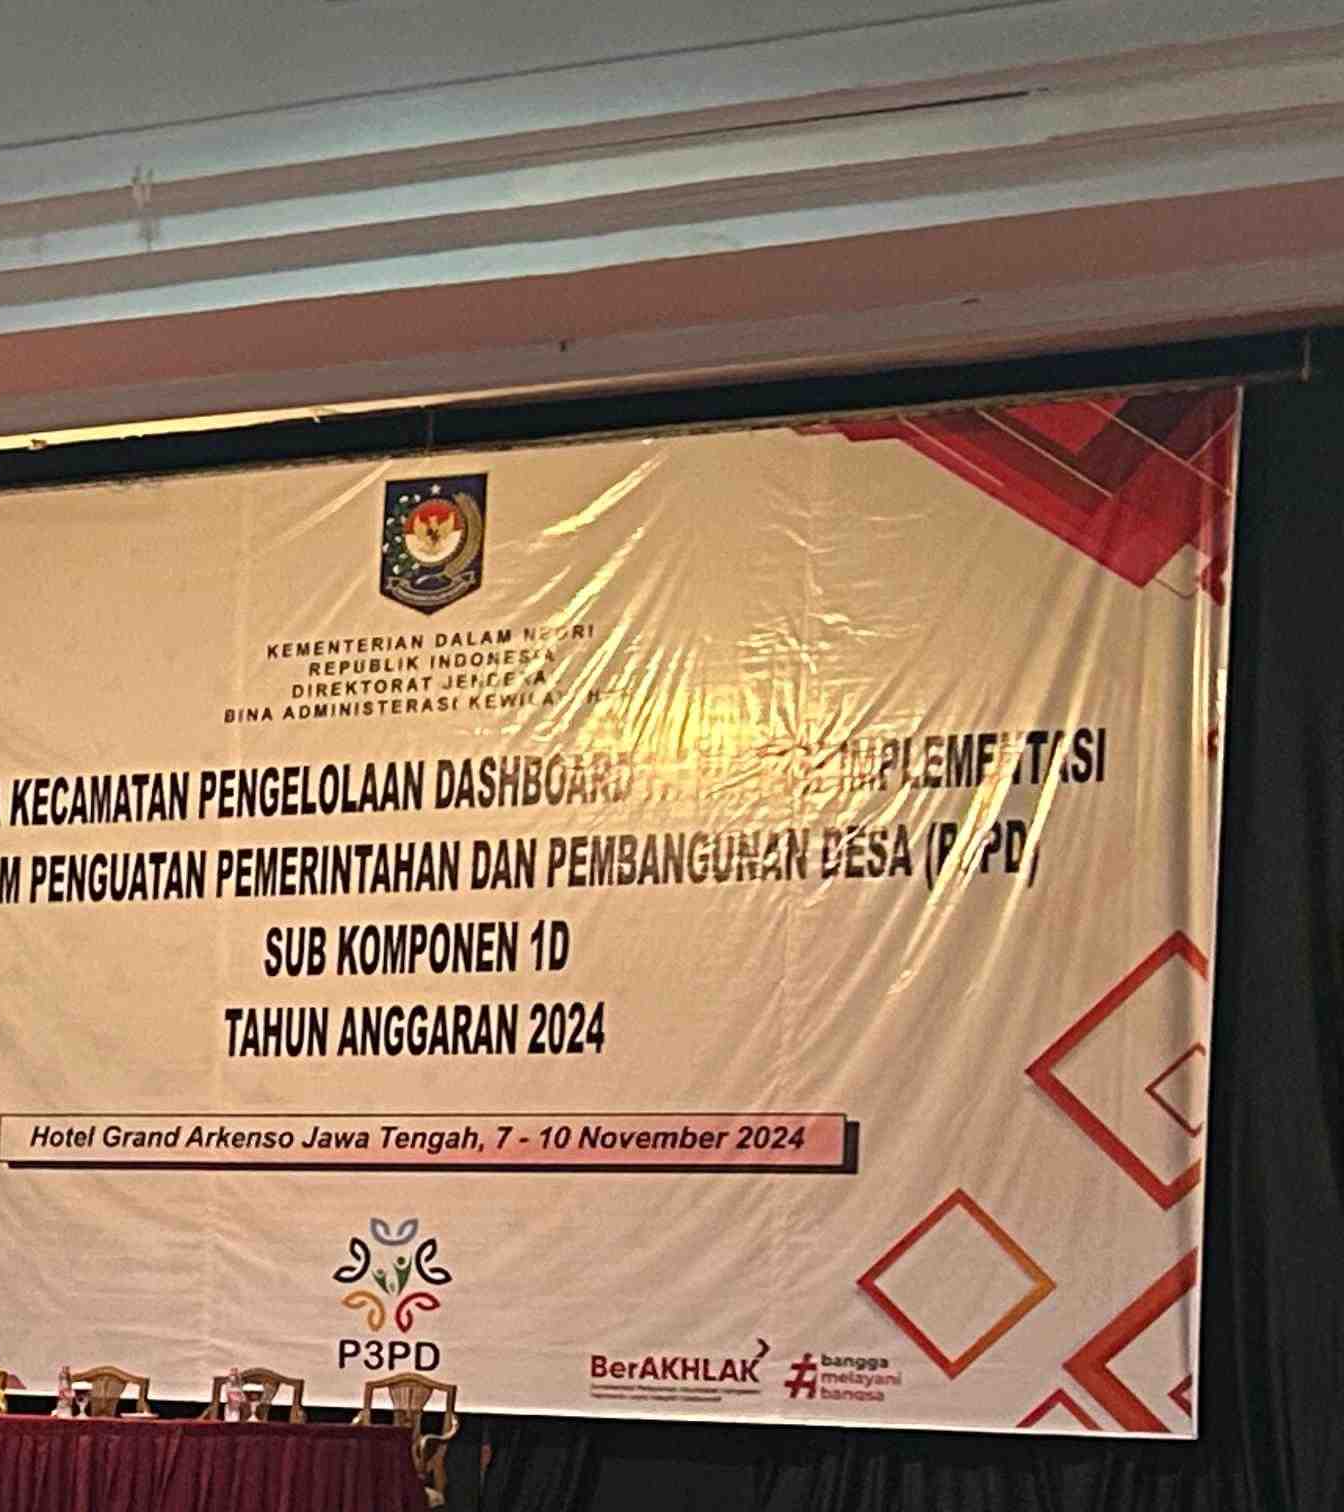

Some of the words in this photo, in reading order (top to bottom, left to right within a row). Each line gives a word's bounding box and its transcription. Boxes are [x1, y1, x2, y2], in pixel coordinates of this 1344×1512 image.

[266, 633, 423, 659] KEMENTERIAN
[435, 629, 512, 648] DALAM
[310, 656, 418, 676] REPUBLIK
[292, 676, 431, 698] DIREKTORAT
[224, 708, 273, 723] BINA
[283, 698, 458, 720] ADMINISTERASI
[11, 771, 189, 827] KECAMATAN
[198, 759, 424, 819] PENGELOLAAN
[30, 849, 205, 903] PENGUATAN
[216, 841, 460, 897] PEMERINTAHAN
[470, 838, 537, 889] DAN
[547, 826, 810, 889] PEMBANGUNAN
[820, 822, 912, 880] DESA
[926, 819, 1040, 891] (PPD)
[264, 926, 328, 976] SUB
[337, 921, 519, 974] KOMPONEN
[530, 919, 570, 972] 1D
[225, 1008, 329, 1057] TAHUN
[337, 1004, 518, 1056] ANGGARAN
[528, 1002, 606, 1055] 2024
[29, 1126, 96, 1148] Hotel
[102, 1126, 181, 1149] Grand
[187, 1126, 295, 1149] Arkenso
[301, 1126, 372, 1149] Jawa
[379, 1125, 488, 1155] Tengah,
[496, 1126, 514, 1148] 7
[538, 1126, 572, 1149] 10
[580, 1126, 728, 1150] November
[736, 1126, 806, 1149] 2024
[337, 1340, 441, 1371] P3PD
[590, 1354, 761, 1383] BerAKHLAK
[820, 1353, 890, 1370] bangga
[821, 1370, 902, 1387] melayani
[820, 1386, 885, 1402] bangsa
